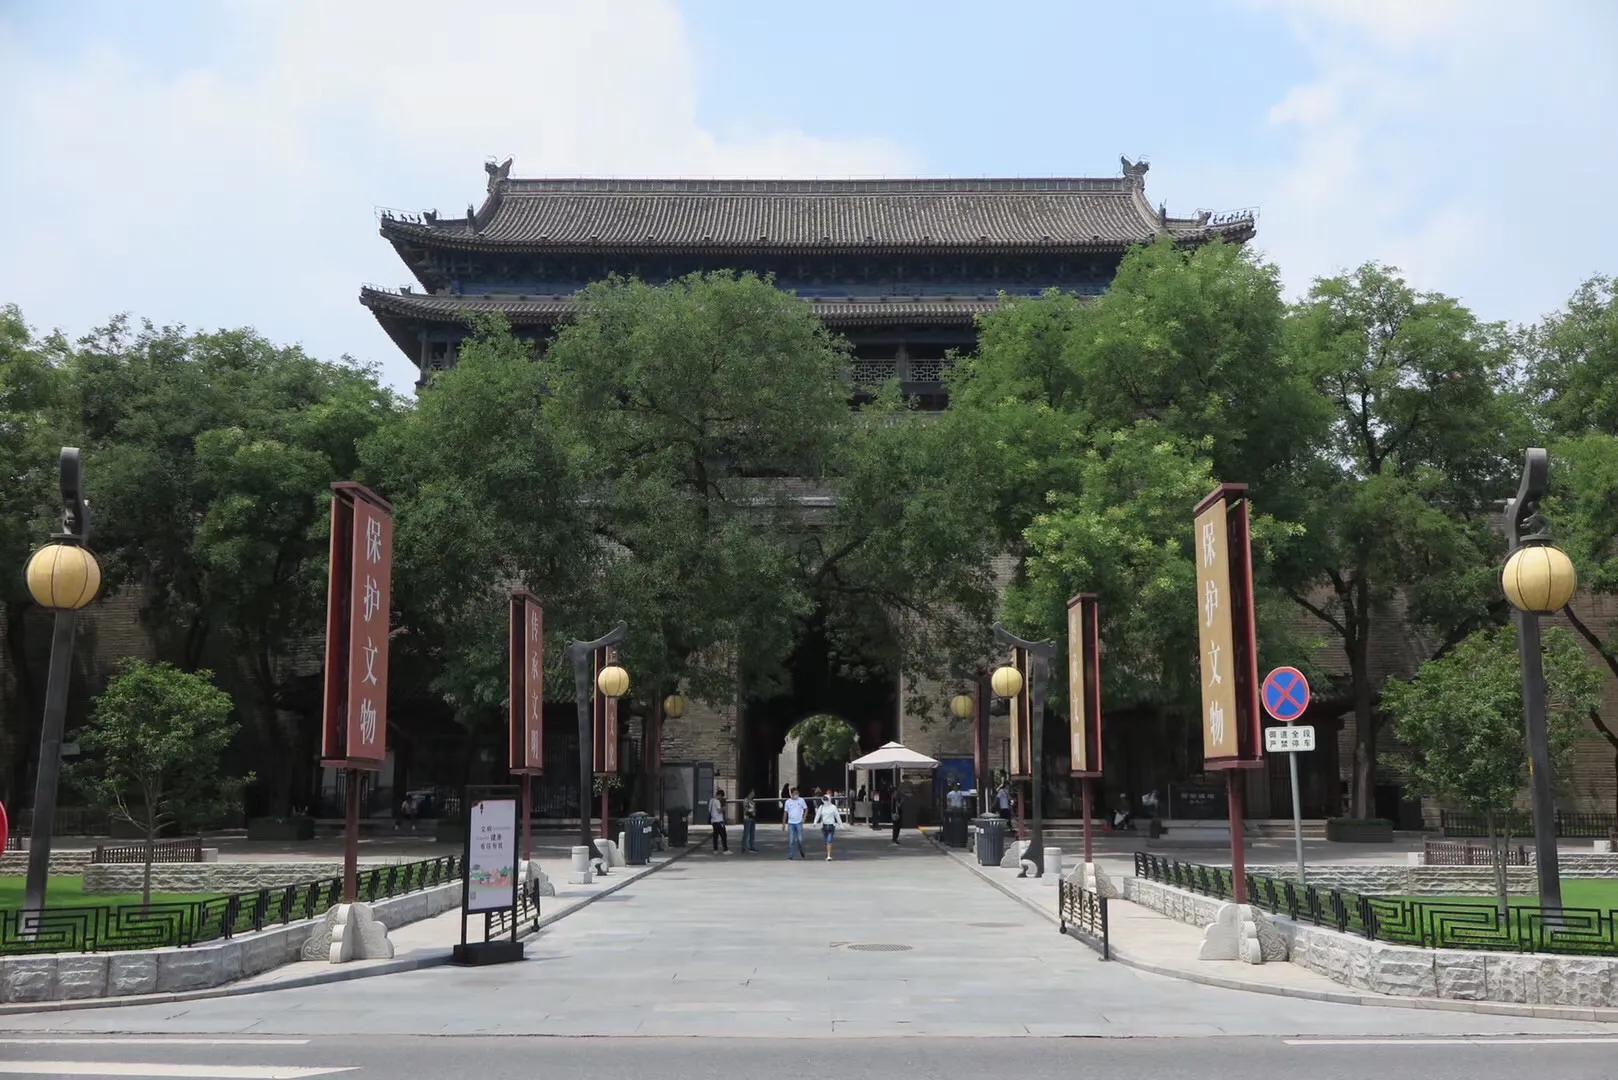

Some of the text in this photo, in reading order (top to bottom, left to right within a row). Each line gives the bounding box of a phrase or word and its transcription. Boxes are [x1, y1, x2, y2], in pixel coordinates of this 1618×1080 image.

[360, 515, 382, 745] 保护文物
[530, 609, 539, 760] 传承文明
[1202, 521, 1224, 746] 保护文物
